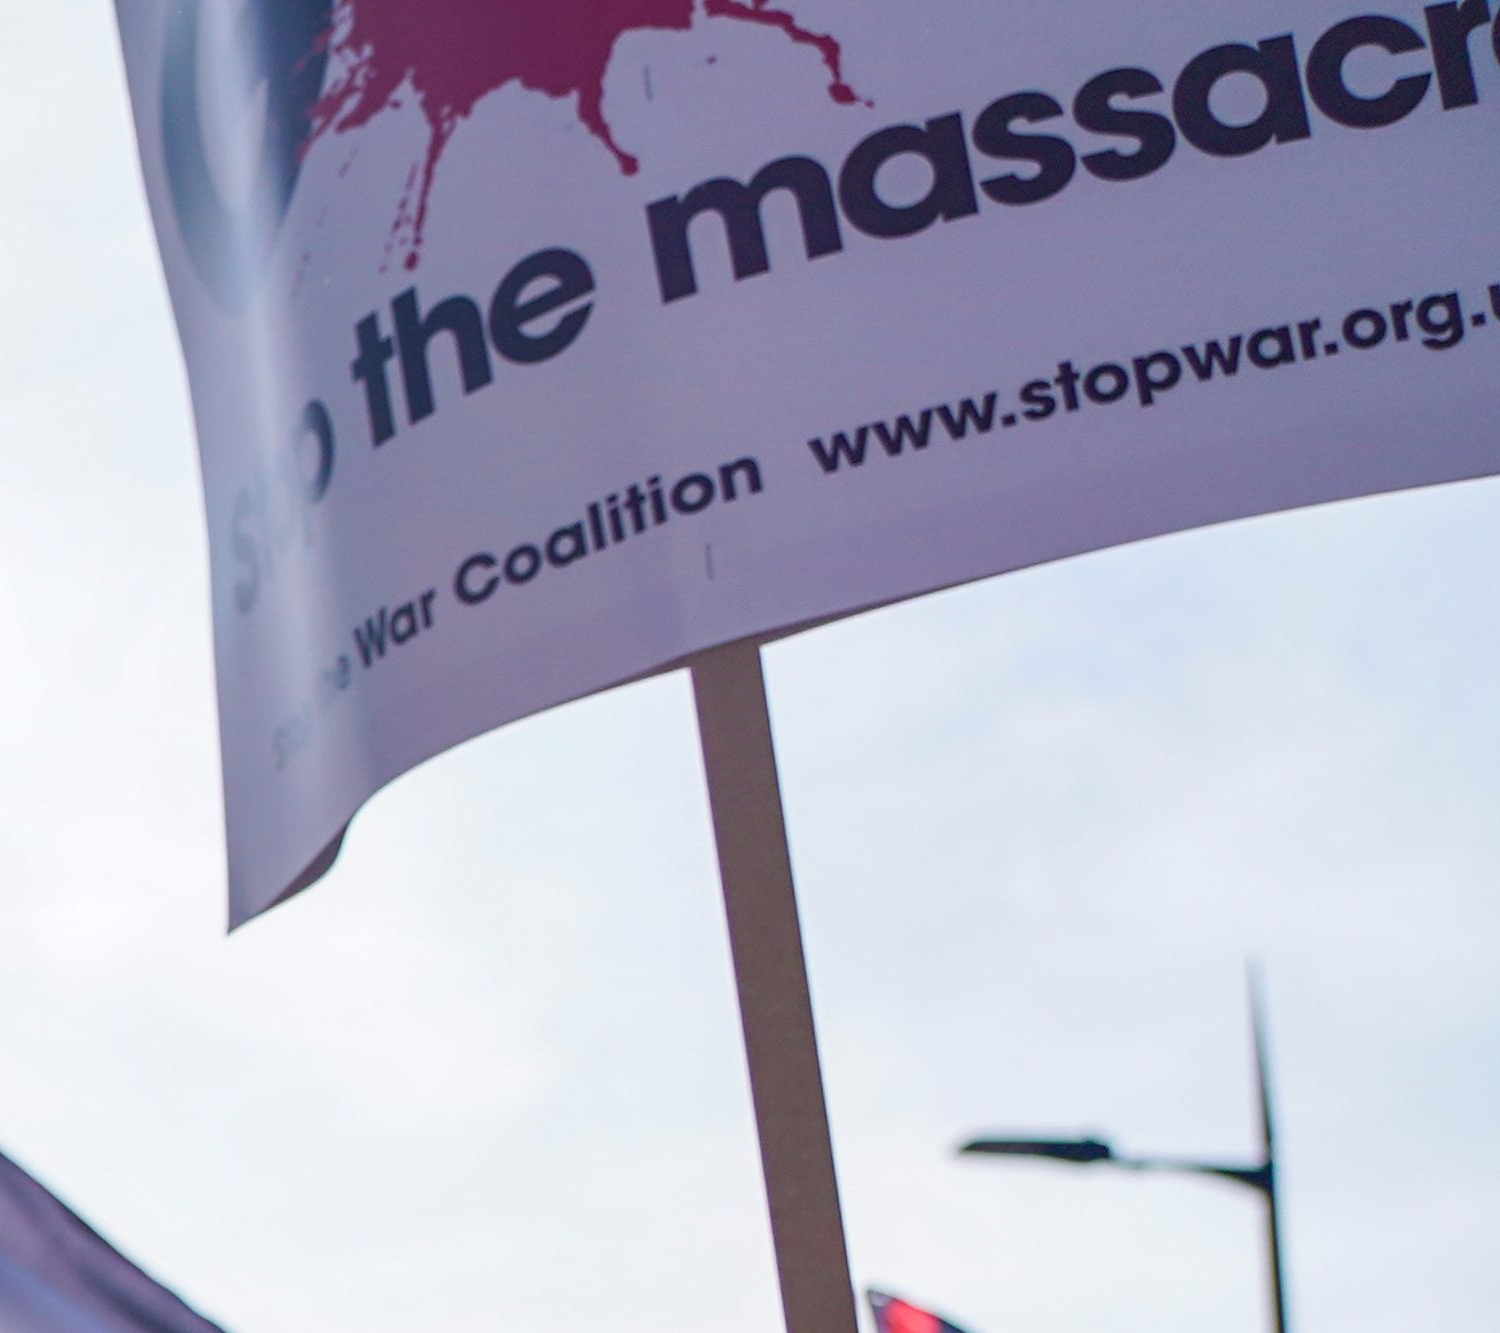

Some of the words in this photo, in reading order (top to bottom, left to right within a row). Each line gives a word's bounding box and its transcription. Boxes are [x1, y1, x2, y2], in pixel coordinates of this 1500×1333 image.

[351, 247, 596, 449] the
[645, 0, 1500, 304] massacr
[353, 588, 437, 669] War
[454, 457, 763, 605] Coalition
[807, 282, 1500, 474] www.stopwar.org.
